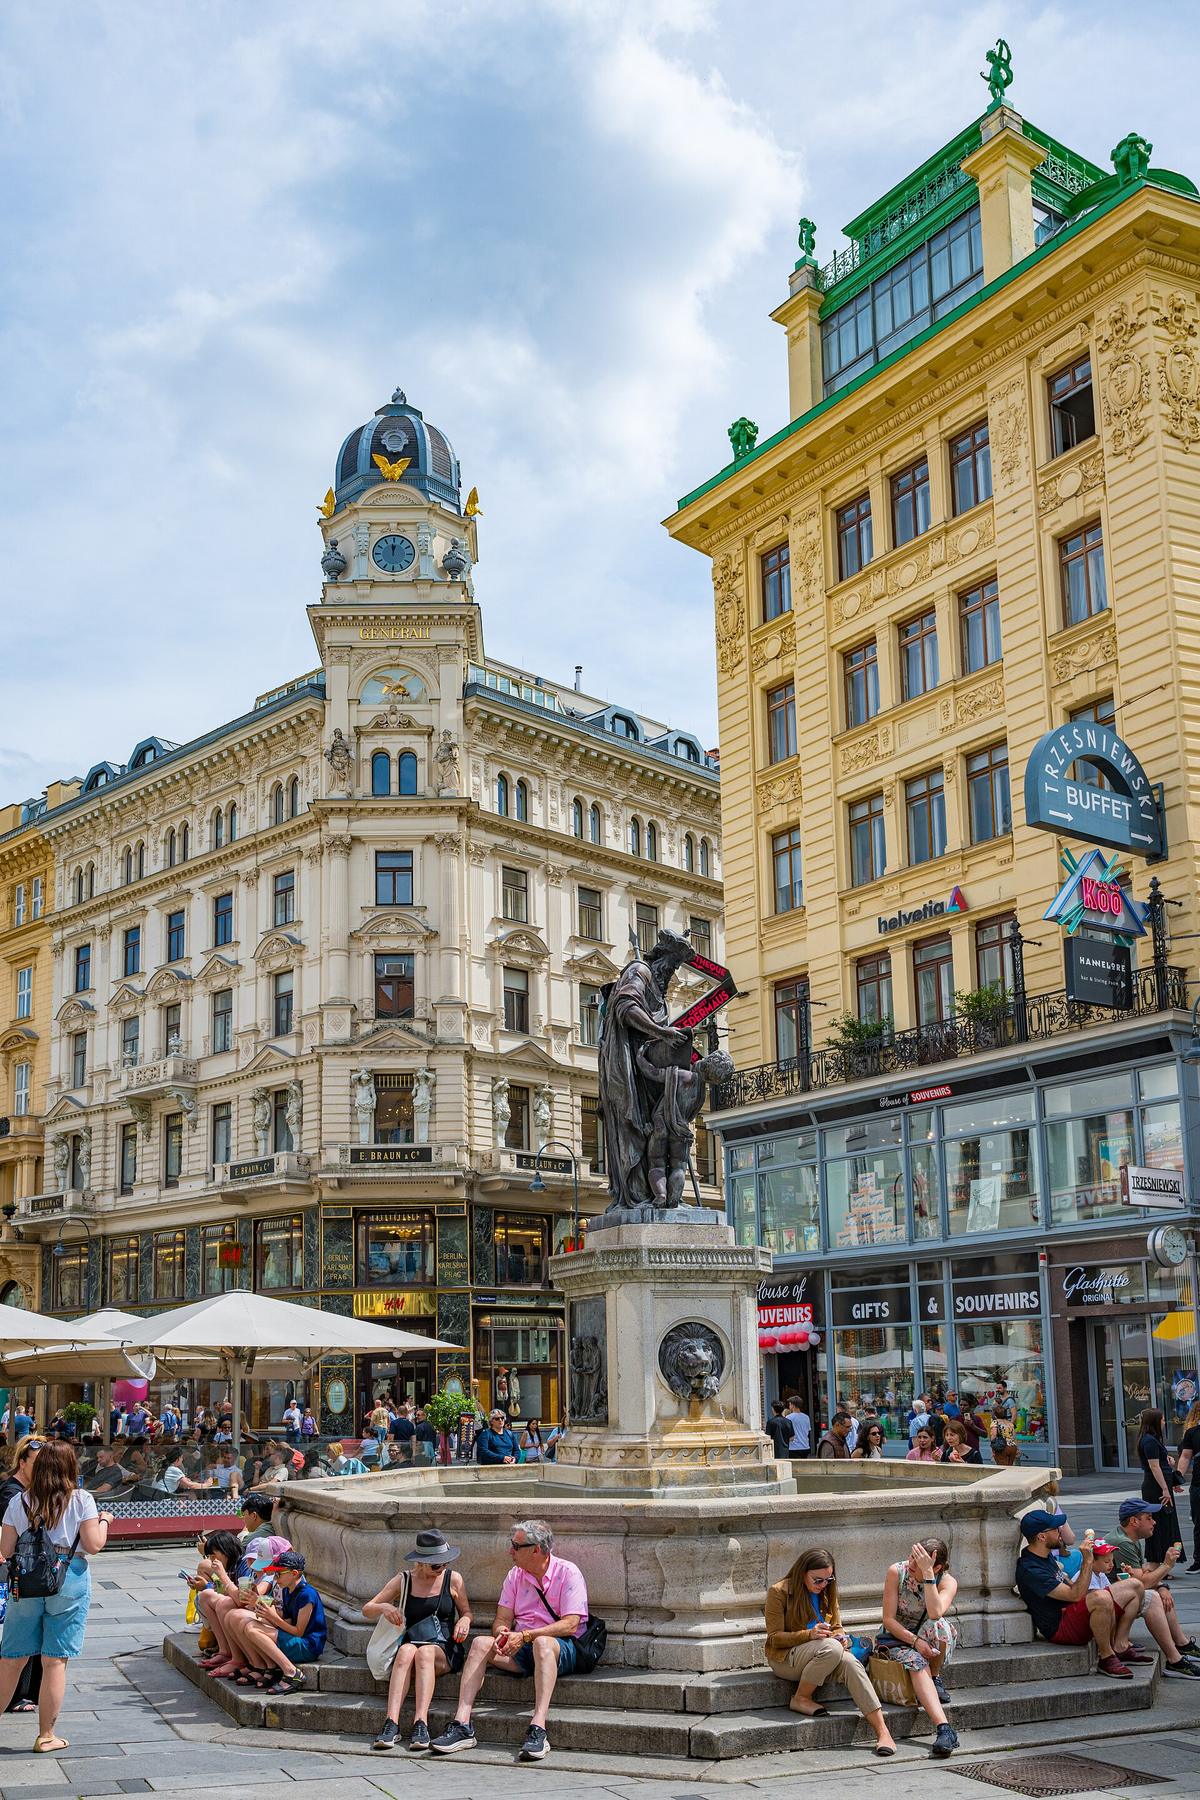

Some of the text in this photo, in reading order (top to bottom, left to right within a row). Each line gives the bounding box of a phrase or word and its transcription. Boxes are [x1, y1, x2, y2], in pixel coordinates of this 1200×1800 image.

[360, 627, 431, 640] GENERALI
[1044, 726, 1154, 820] TRZEŚNIEWSKI
[1066, 785, 1132, 821] BUFFET
[1082, 876, 1122, 915] KÖÖ
[877, 899, 945, 934] helvetia
[694, 954, 727, 977] THEQUE
[1079, 956, 1126, 972] HANNELORE
[680, 991, 730, 1029] EDERMAUS
[879, 1086, 952, 1108] House of SOUVENIRS
[360, 1151, 368, 1161] E.
[370, 1151, 401, 1160] BRAUN
[1131, 1175, 1181, 1192] TRZEŚNIEWSKI
[323, 1263, 353, 1271] KARLSBAD
[437, 1261, 468, 1269] KARLSBAD
[792, 1276, 807, 1303] of
[1062, 1266, 1131, 1299] Glashütte
[384, 1296, 405, 1311] H&M
[852, 1291, 1040, 1319] GIFTS & SOUVENIRS
[1082, 1293, 1114, 1303] ORIGINAL
[757, 1305, 812, 1324] UVENIRS
[872, 1679, 908, 1705] ARA
